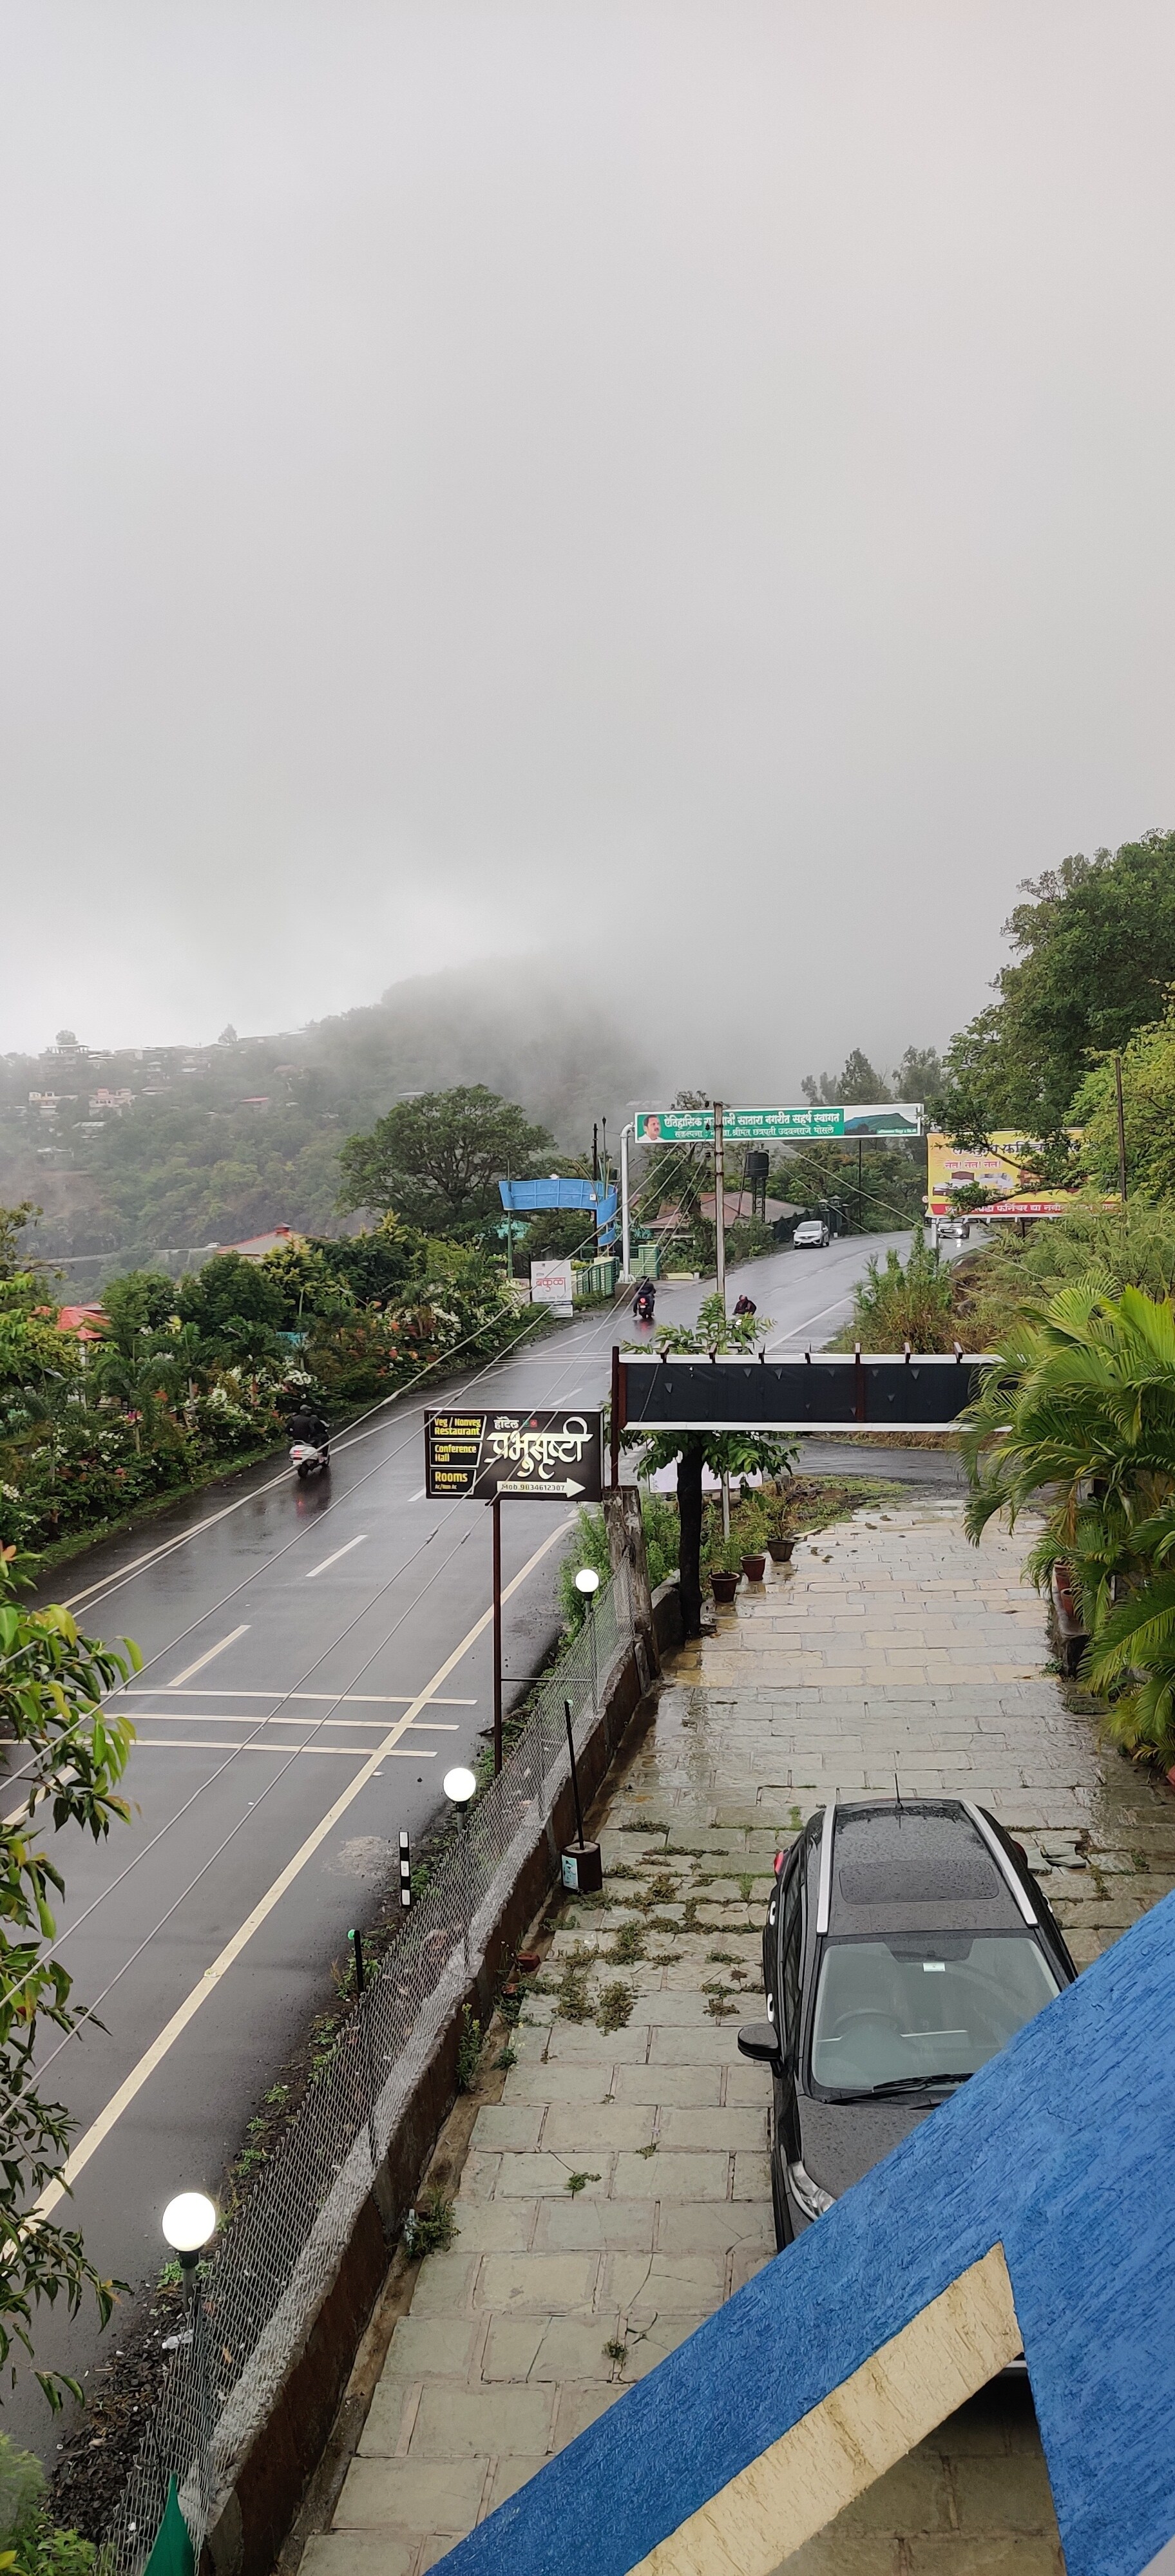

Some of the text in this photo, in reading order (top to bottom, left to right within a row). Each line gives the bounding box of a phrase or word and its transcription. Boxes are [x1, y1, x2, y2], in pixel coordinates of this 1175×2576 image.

[664, 1115, 702, 1128] ऐतिहासिक
[737, 1115, 763, 1126] सातारा
[765, 1111, 790, 1124] नगरीत
[792, 1110, 812, 1124] सहर्ष
[814, 1113, 840, 1123] स्वागत
[752, 1126, 776, 1135] छत्रपती
[434, 1418, 448, 1427] Veg
[454, 1418, 481, 1428] Nonveg
[493, 1416, 519, 1430] हॉटेल
[434, 1427, 481, 1435] Restaurant
[434, 1444, 477, 1453] Conference
[435, 1454, 450, 1462] Hall
[435, 1472, 468, 1482] Rooms
